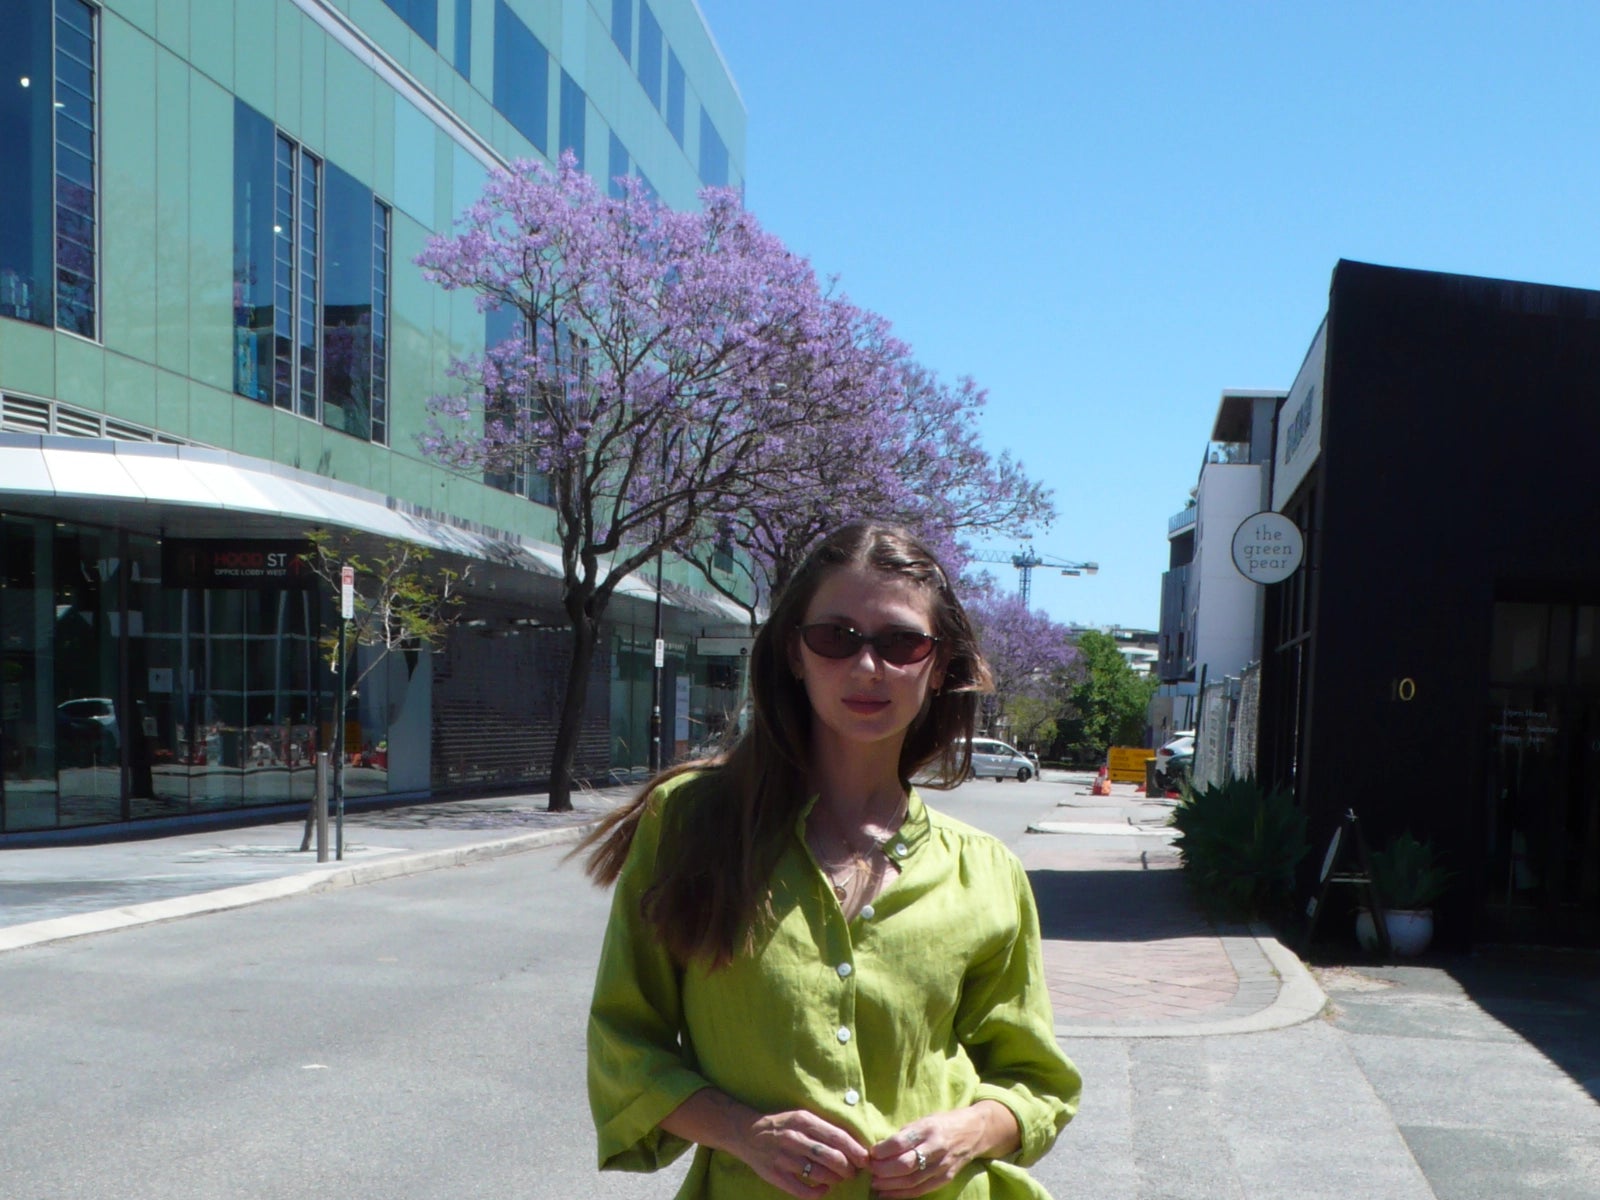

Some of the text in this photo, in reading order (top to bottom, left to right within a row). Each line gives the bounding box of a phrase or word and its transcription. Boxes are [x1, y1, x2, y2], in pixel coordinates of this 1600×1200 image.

[1255, 524, 1282, 540] the
[1243, 544, 1292, 559] green
[214, 553, 287, 567] HOOD ST
[1248, 559, 1288, 573] pear
[214, 568, 287, 576] OFFICE LOBBY WEST
